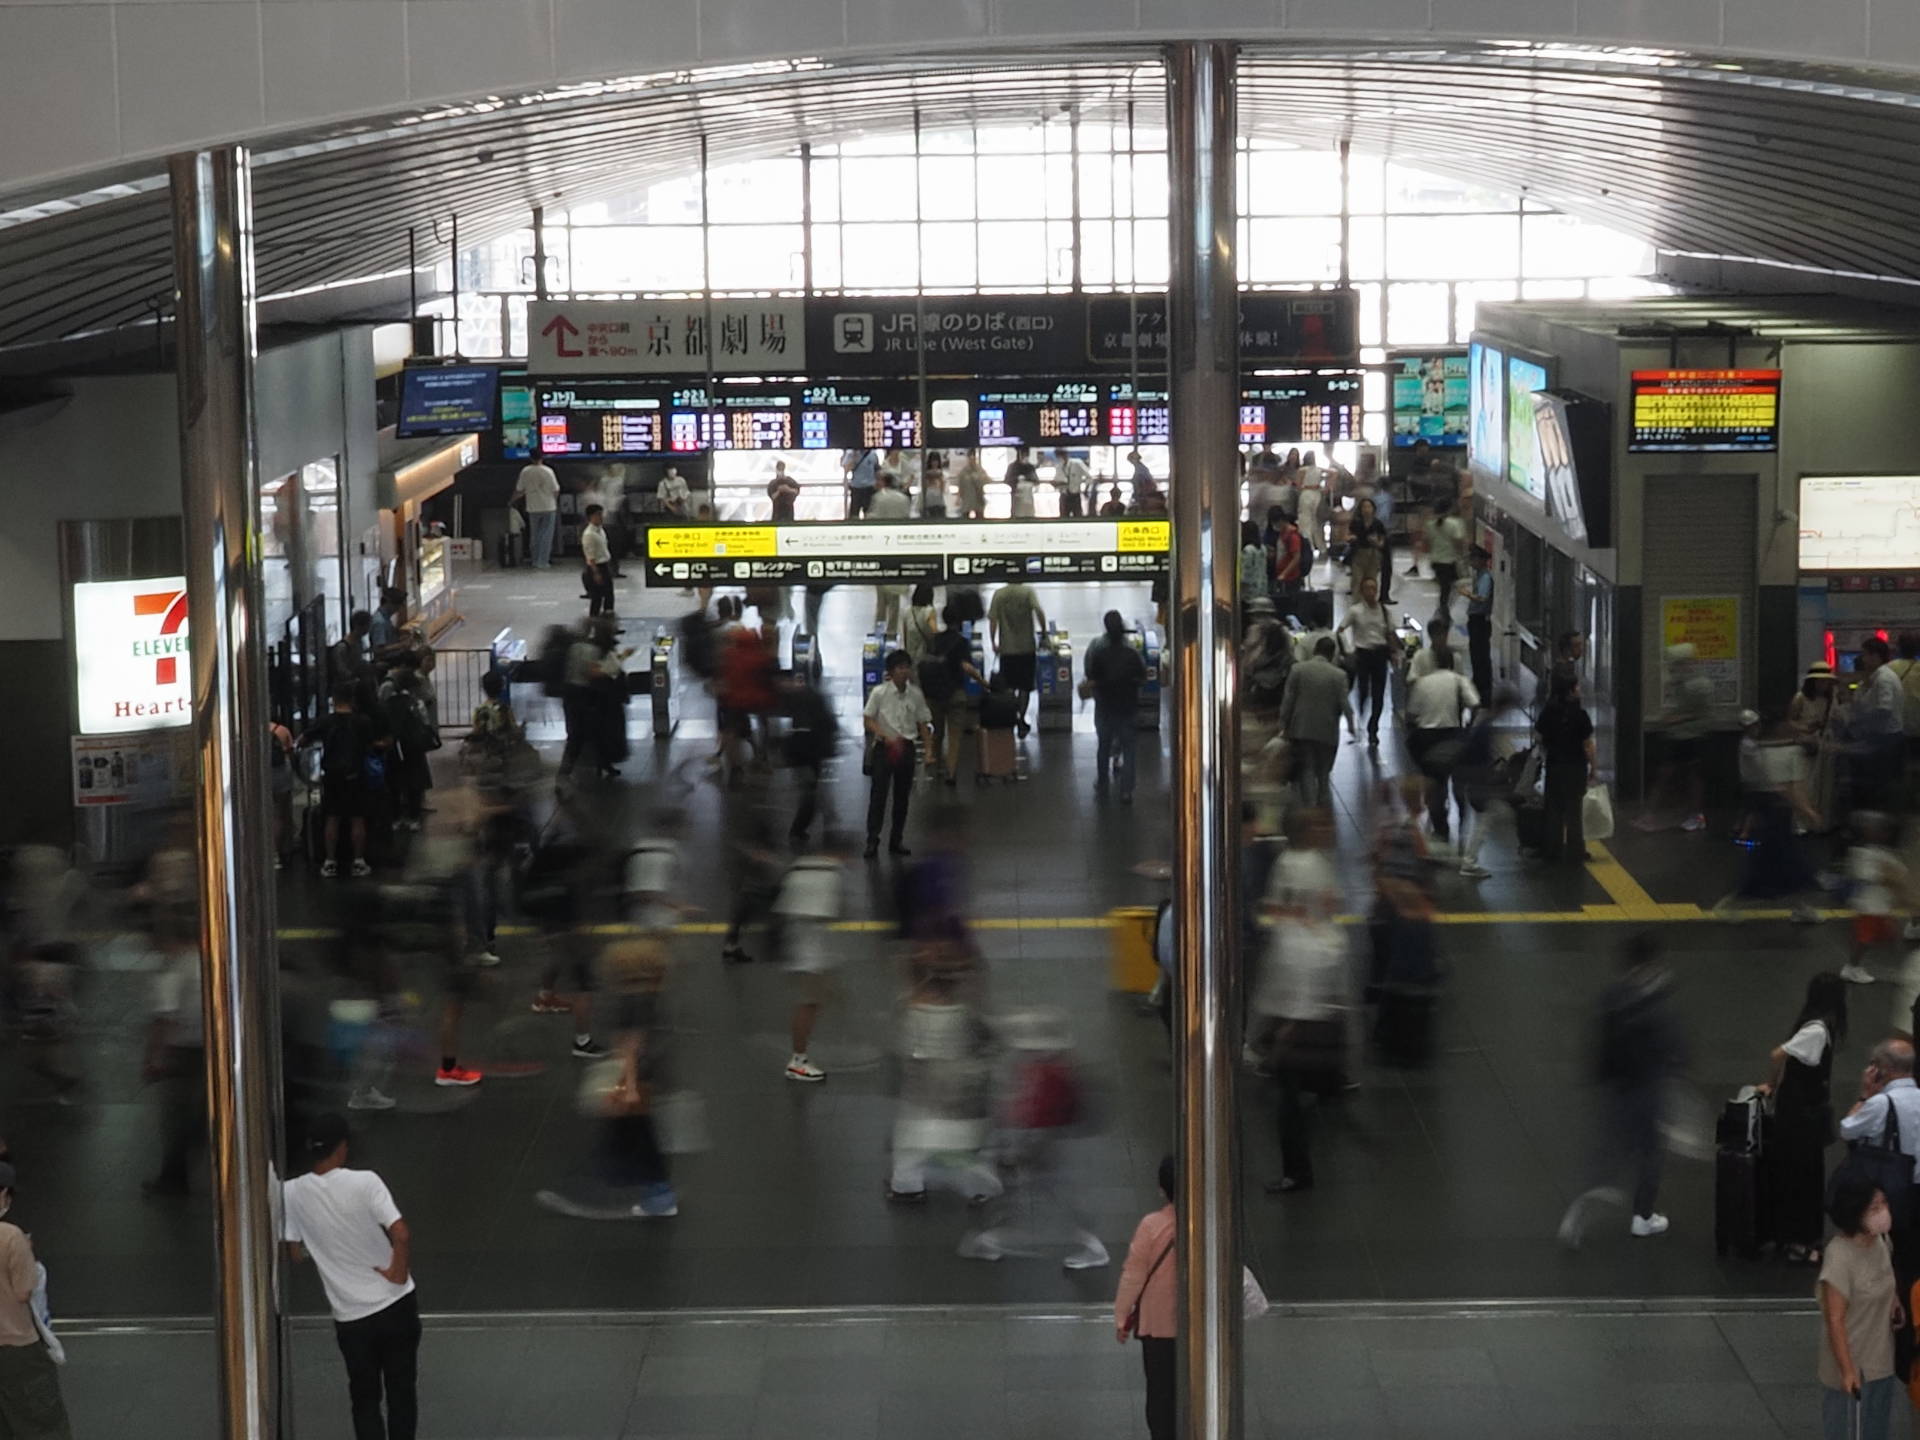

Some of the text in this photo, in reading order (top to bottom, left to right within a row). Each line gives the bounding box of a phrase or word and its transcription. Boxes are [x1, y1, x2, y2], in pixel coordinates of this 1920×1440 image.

[646, 314, 786, 356] 京都劇場
[885, 338, 901, 351] JR
[942, 336, 986, 352] (West
[991, 336, 1034, 352] Gate)
